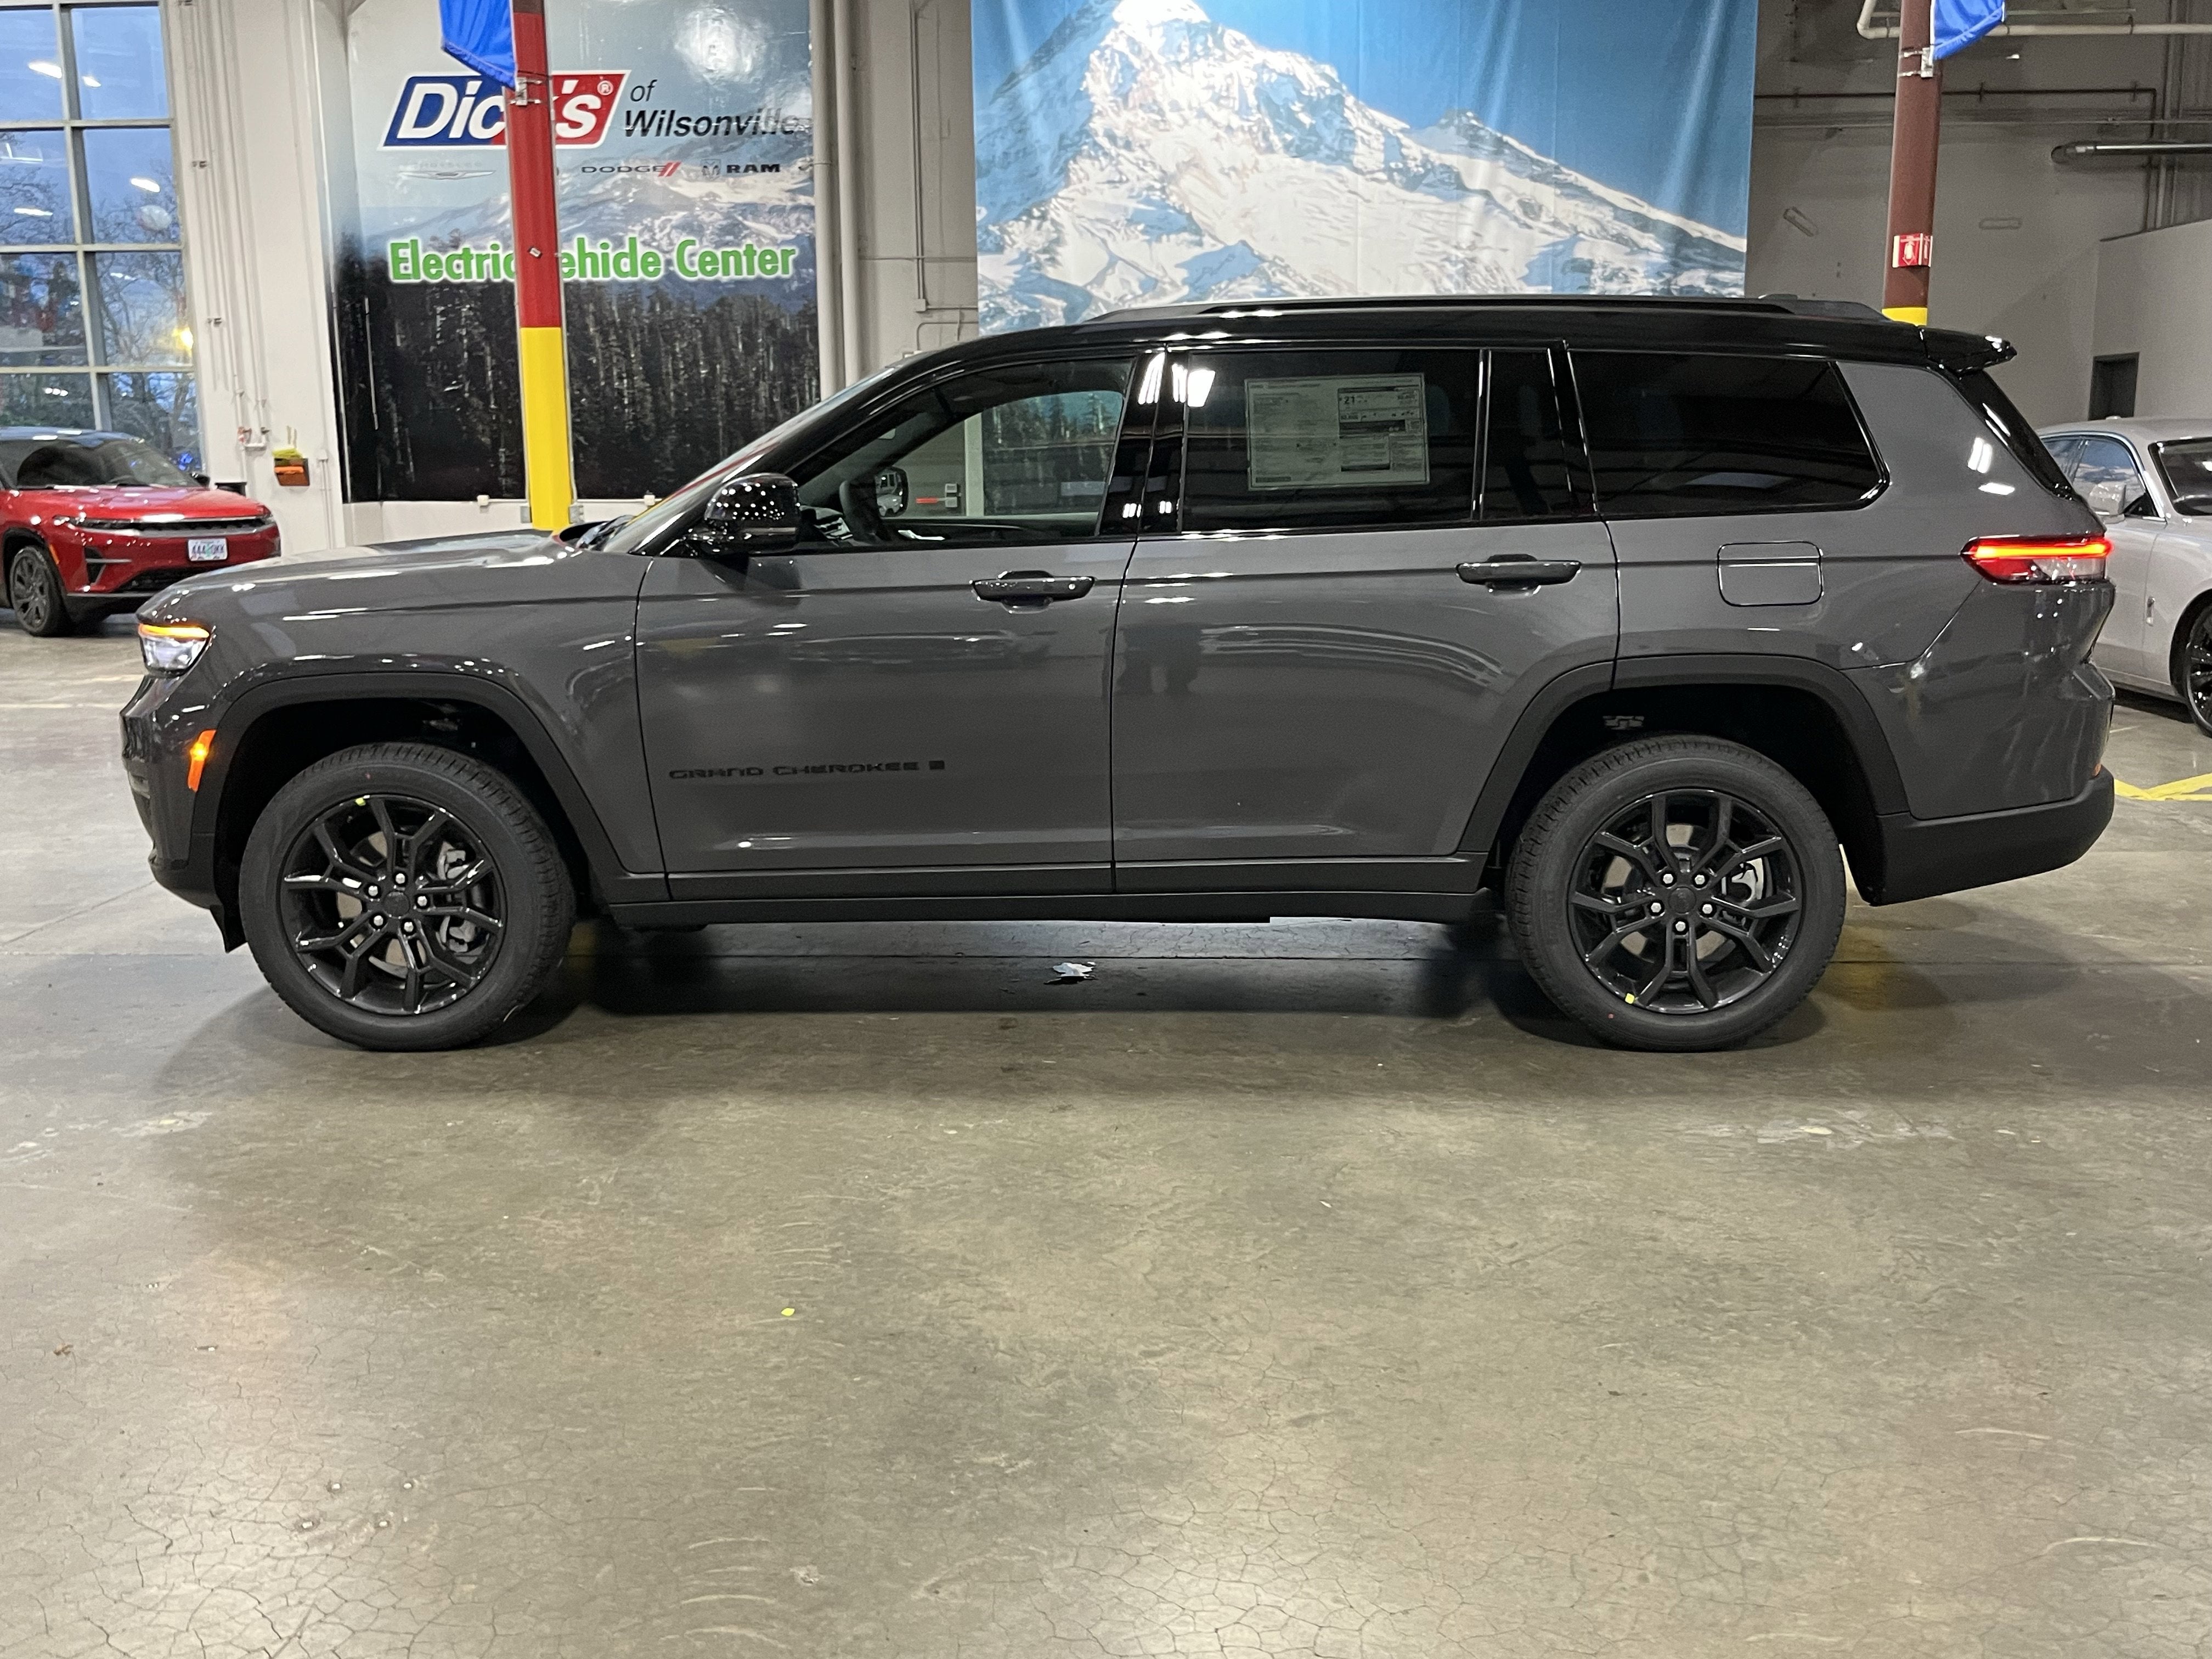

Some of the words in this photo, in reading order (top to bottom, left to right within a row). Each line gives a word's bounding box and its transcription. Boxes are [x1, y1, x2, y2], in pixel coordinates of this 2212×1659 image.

[630, 79, 657, 102] of
[396, 80, 602, 139] Dic's
[726, 164, 781, 174] RAM
[561, 237, 662, 279] ehicle
[676, 239, 796, 278] Center
[669, 767, 764, 779] GRAND
[772, 761, 919, 775] CHEROKEE
